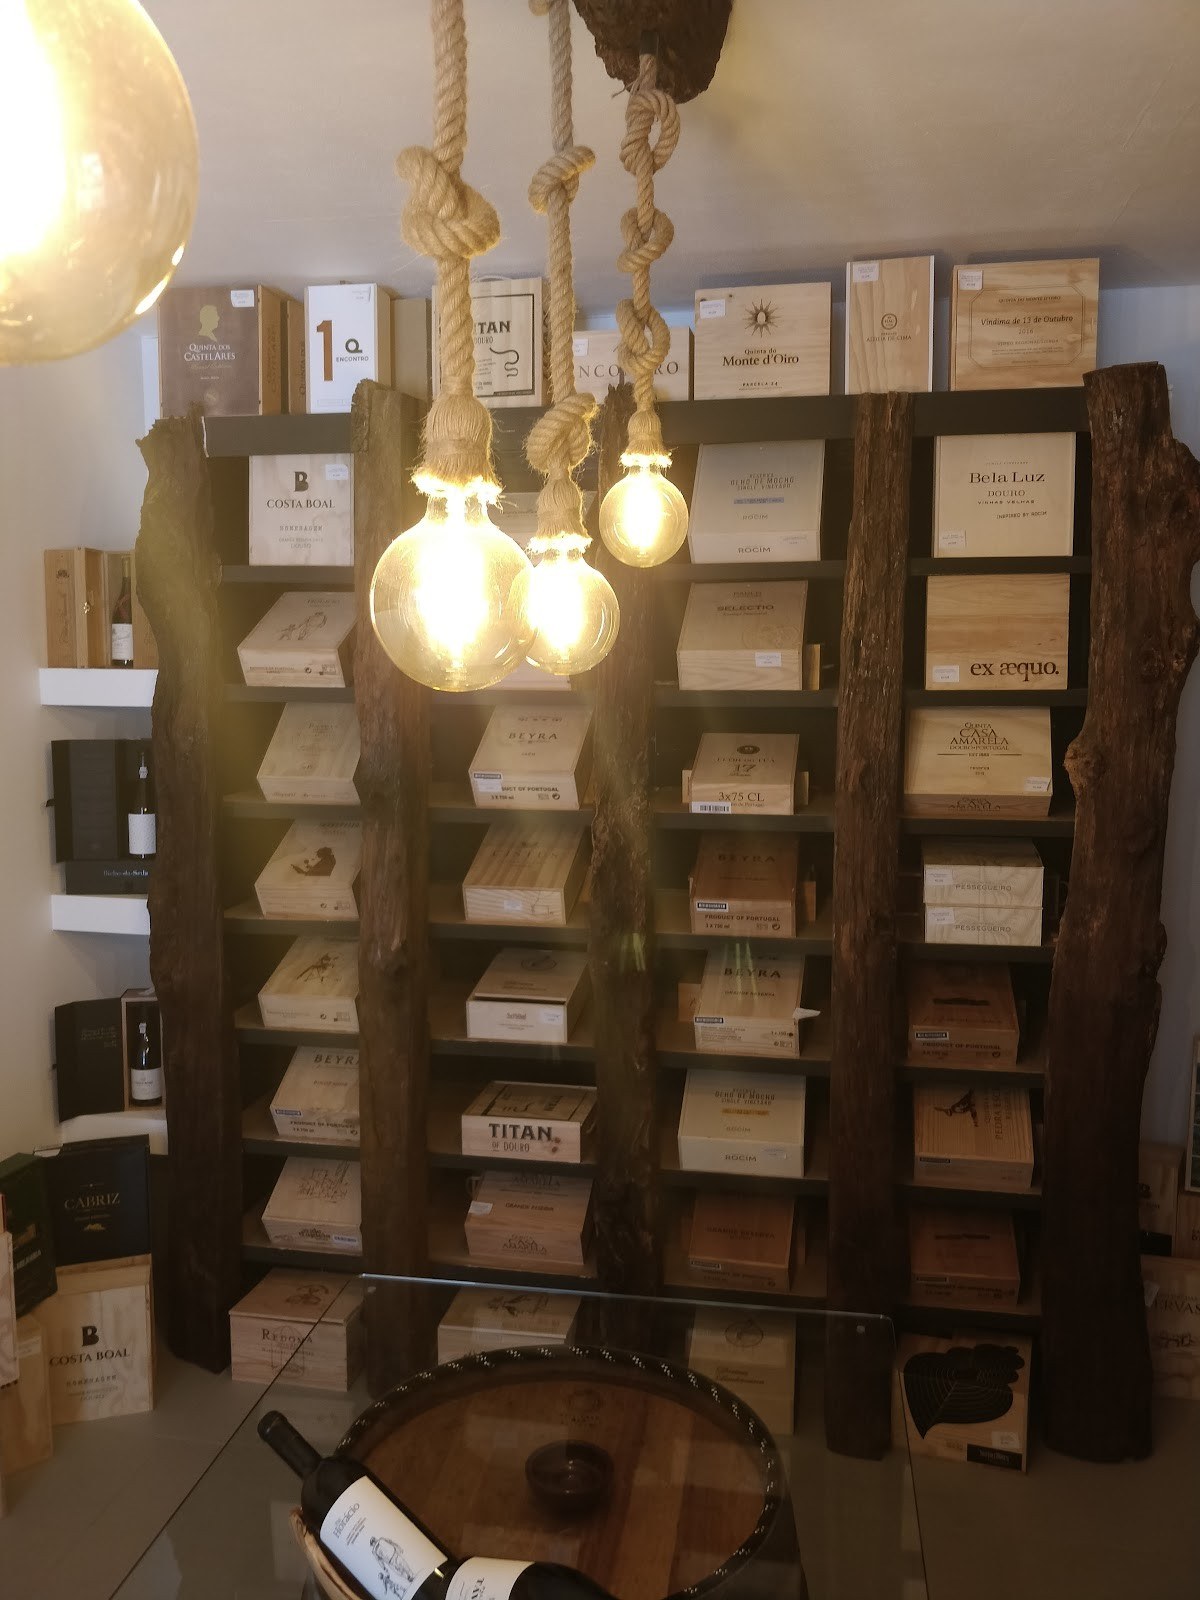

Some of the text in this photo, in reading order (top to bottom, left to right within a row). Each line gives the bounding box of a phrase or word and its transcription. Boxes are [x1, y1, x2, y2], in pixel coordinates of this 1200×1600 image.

[981, 317, 1010, 326] Vindima
[1044, 314, 1073, 322] Outubro
[189, 343, 217, 353] QUINTA
[316, 320, 333, 382] 1
[183, 353, 237, 362] CASTELARES
[722, 355, 760, 367] Monte
[294, 471, 309, 492] B
[969, 471, 1046, 484] Bela Luz
[988, 489, 1026, 497] DOURO
[266, 499, 335, 509] COSTA BOAL
[717, 604, 774, 612] SELECTIO
[970, 661, 1059, 682] ex æquo.
[964, 721, 992, 730] QUINTA
[508, 732, 558, 741] BEYRA
[959, 728, 998, 738] CASA
[950, 737, 1009, 745] AMARELA
[718, 791, 765, 802] 3x75 CL
[718, 855, 777, 864] BEYRA
[955, 883, 1012, 891] PESSEGUEIRO
[955, 923, 1012, 932] PESSEGUEIRO
[724, 967, 782, 979] BEYRA
[488, 1123, 553, 1142] TITAN
[503, 1141, 530, 1153] DOURO
[725, 1154, 758, 1162] ROCIM
[64, 1193, 120, 1210] CABRIZ
[82, 1325, 99, 1347] B
[50, 1348, 129, 1366] COSTA BOAL
